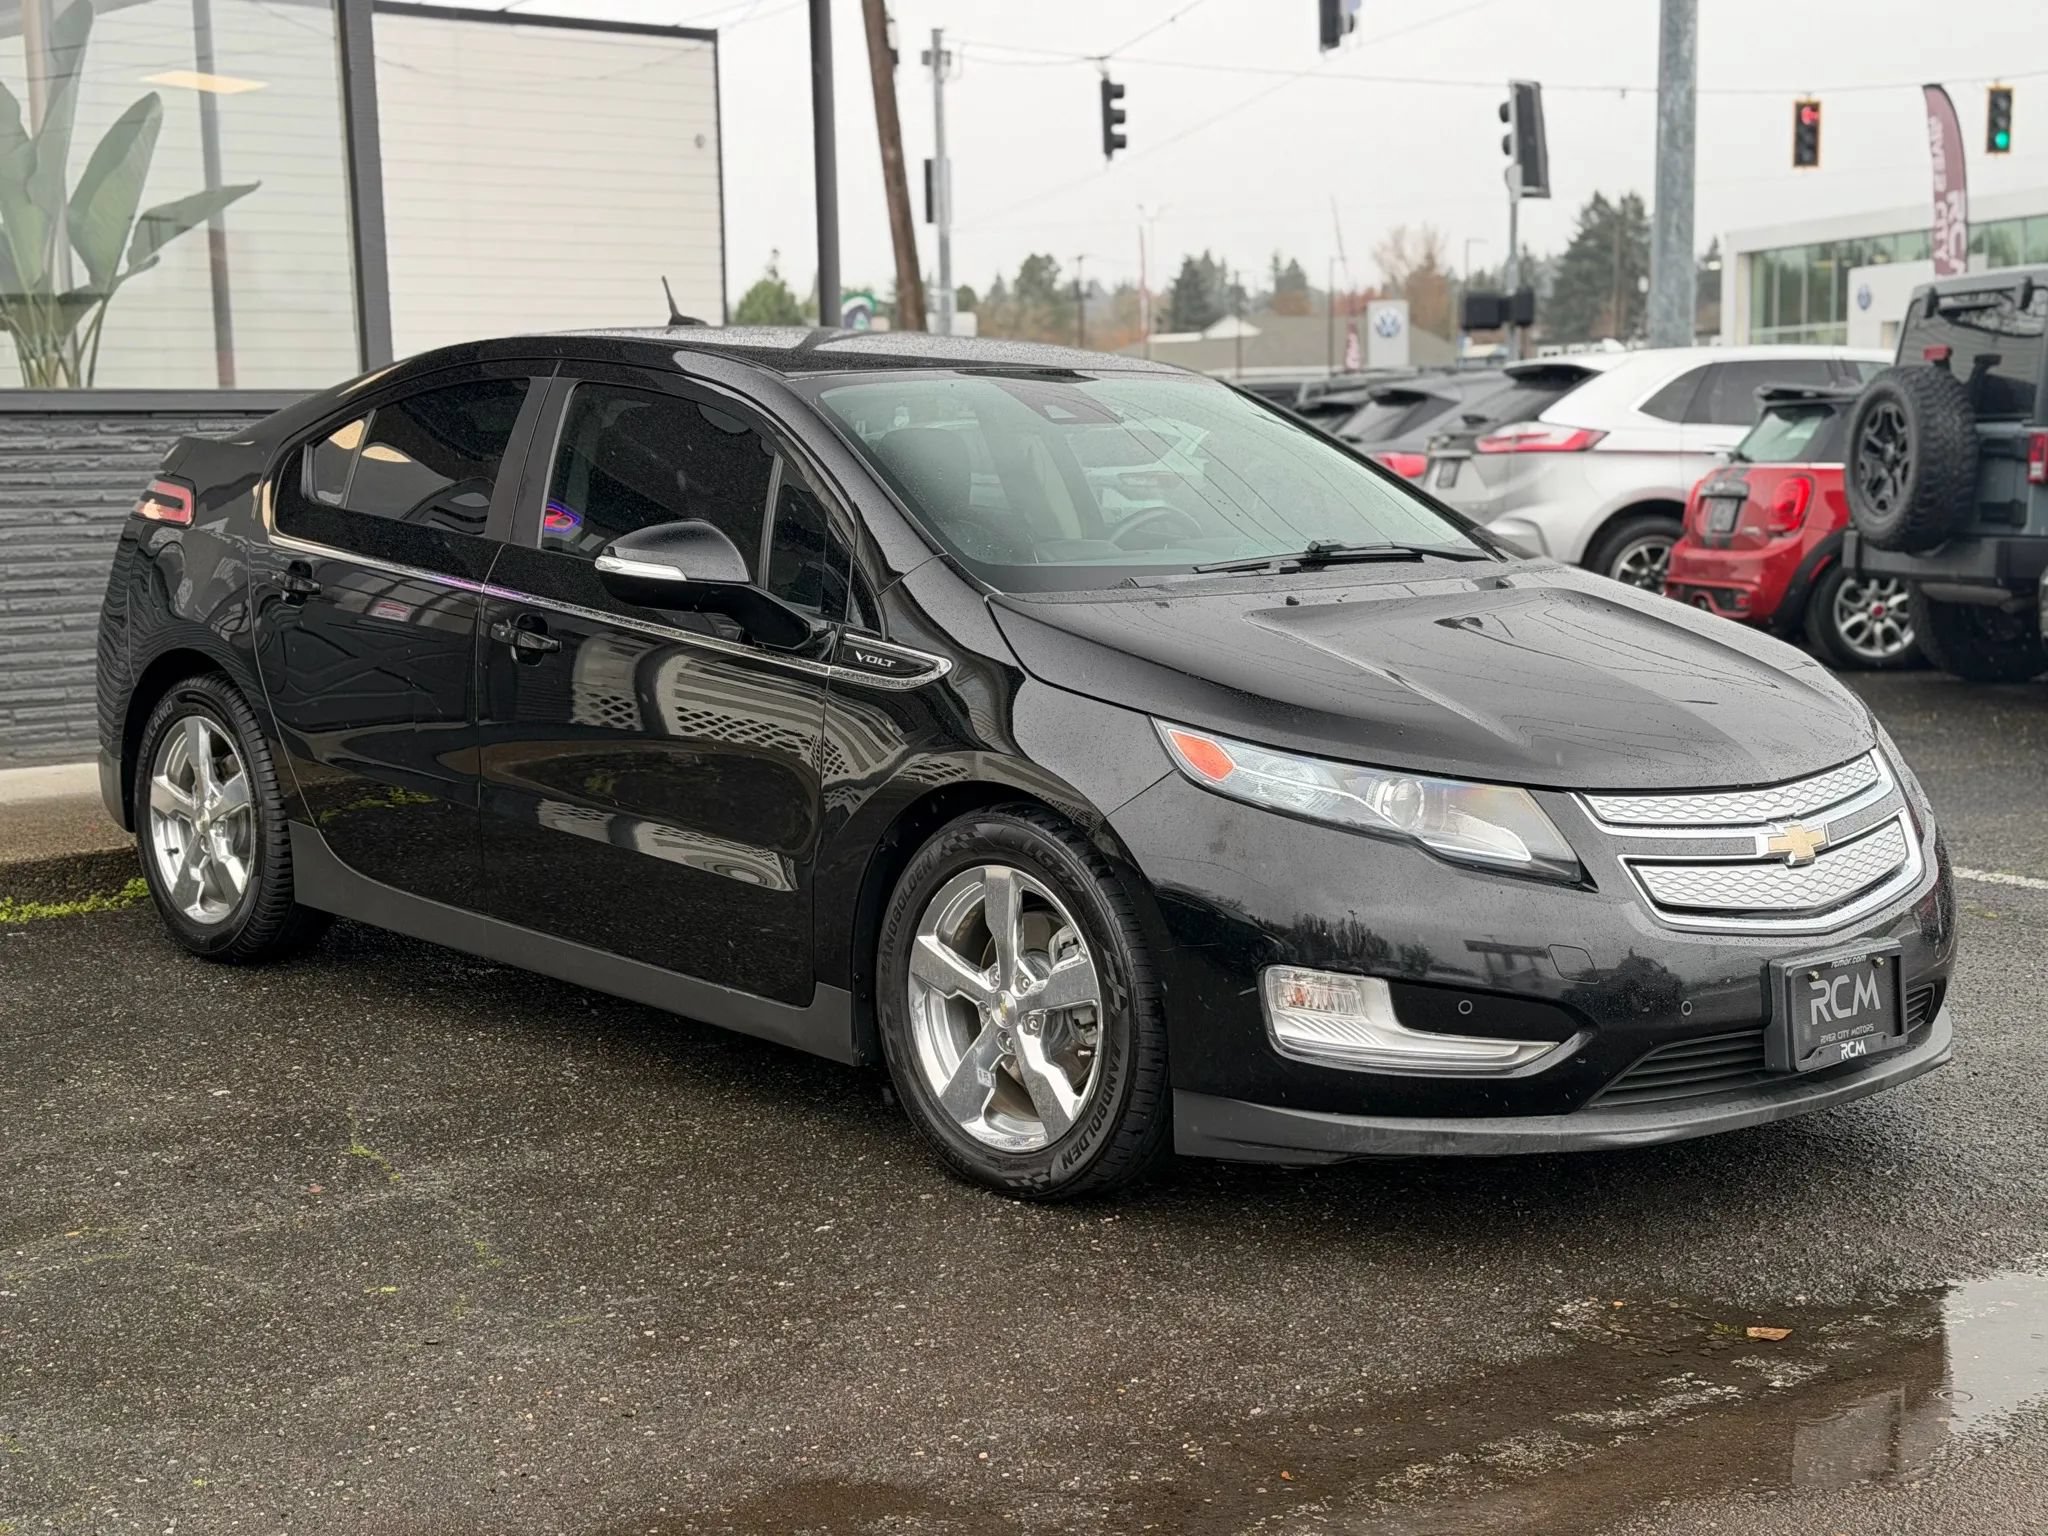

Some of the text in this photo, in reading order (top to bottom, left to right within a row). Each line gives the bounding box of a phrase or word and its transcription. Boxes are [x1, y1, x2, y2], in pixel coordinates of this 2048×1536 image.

[1934, 201, 1948, 262] CITY
[855, 650, 897, 668] VOLT
[1809, 970, 1881, 1025] RCM
[1820, 1023, 1875, 1044] RIVER CITY MOTORS
[1839, 1040, 1867, 1060] RCM
